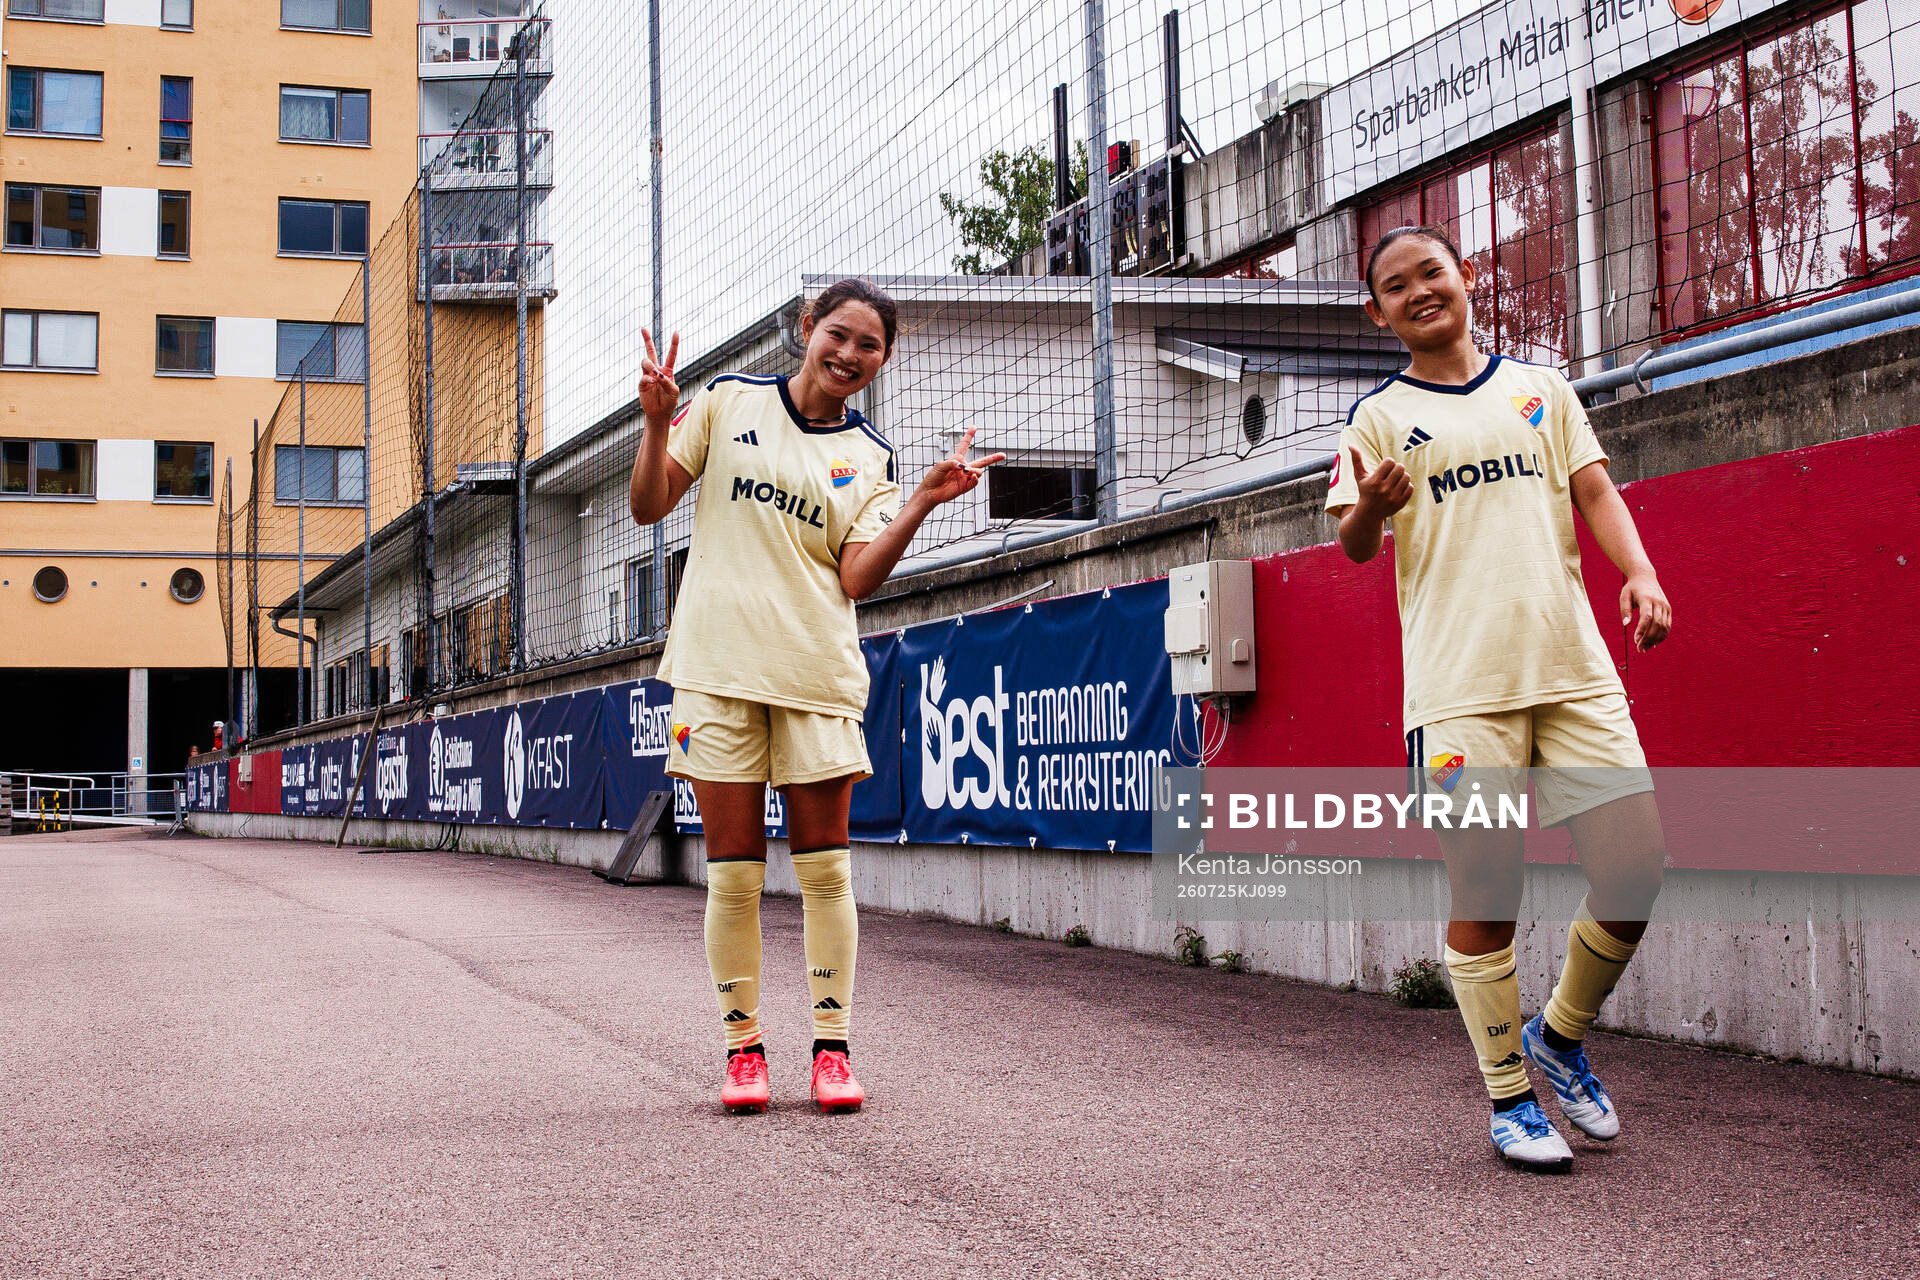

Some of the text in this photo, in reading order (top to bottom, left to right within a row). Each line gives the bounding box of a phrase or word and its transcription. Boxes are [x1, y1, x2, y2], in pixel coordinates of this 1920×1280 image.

[1355, 54, 1492, 152] Sparbanken
[731, 476, 825, 529] MOBILL
[1427, 453, 1544, 504] MOBILL
[919, 655, 1011, 811] best
[1016, 680, 1129, 747] BEMANNING
[375, 736, 408, 815] logistik
[444, 736, 473, 769] Eskilstuna
[527, 733, 573, 790] KFAST
[443, 778, 463, 817] Energi
[1015, 748, 1172, 812] & REKRYTERING
[717, 982, 737, 993] DIF
[812, 968, 838, 979] DIF
[1486, 1021, 1512, 1037] DIF
